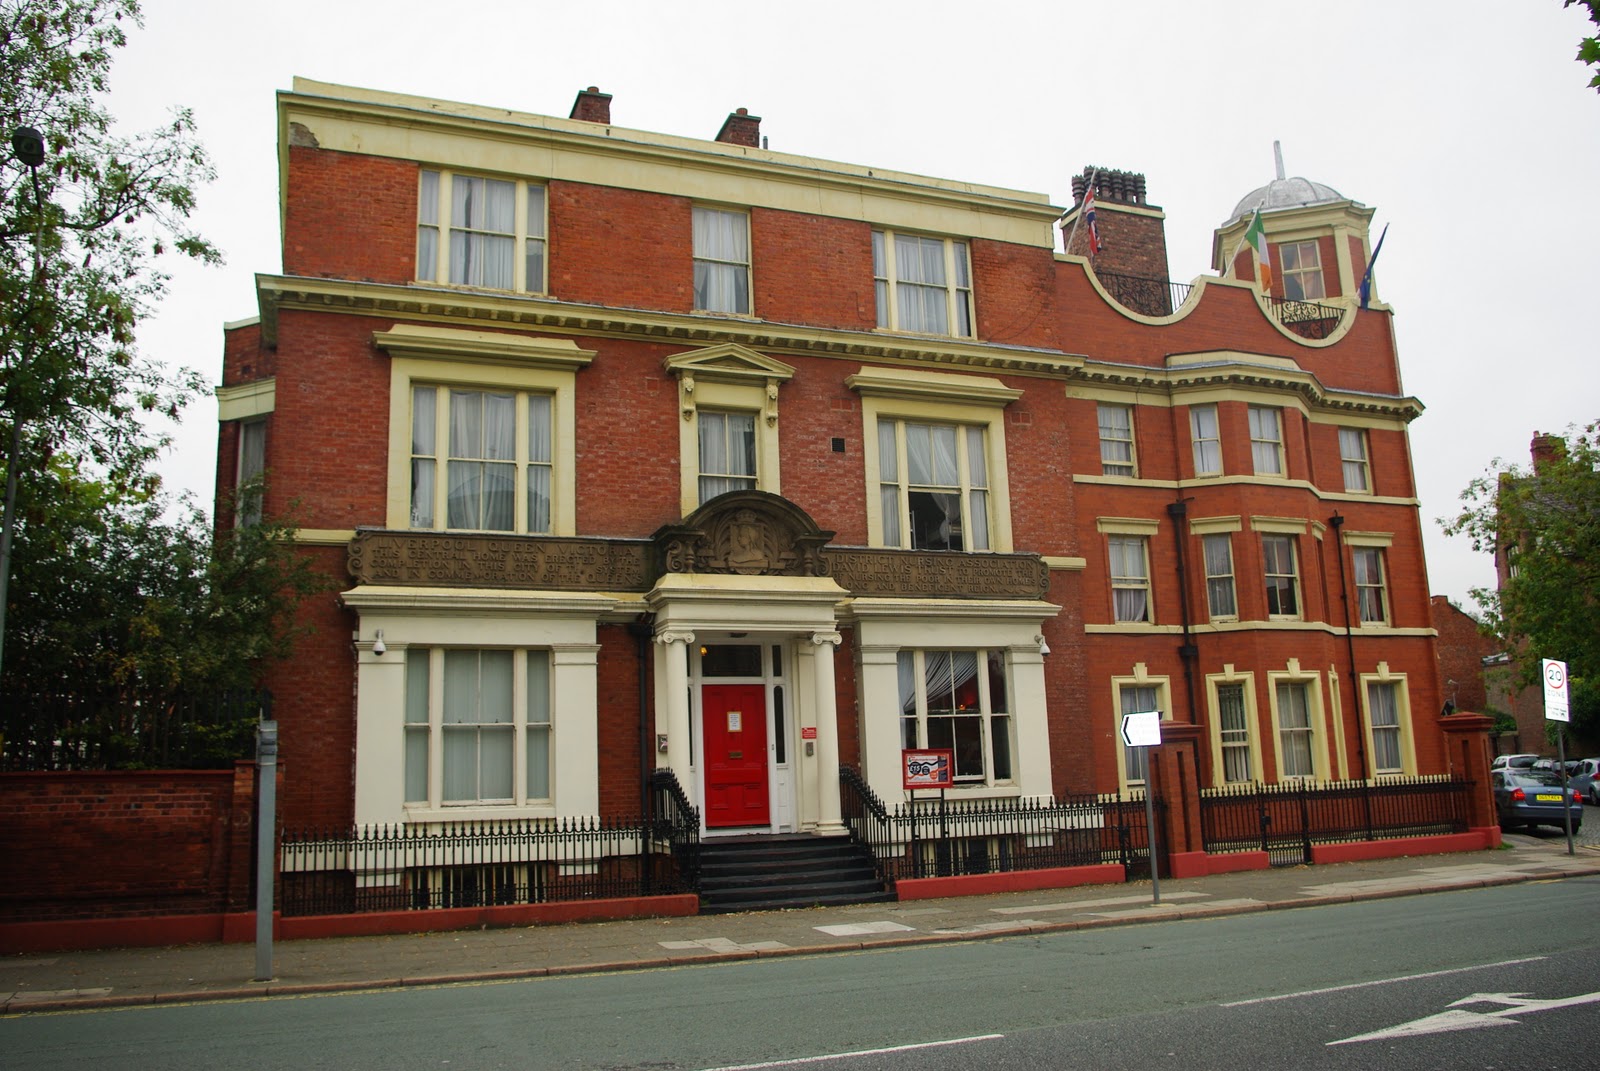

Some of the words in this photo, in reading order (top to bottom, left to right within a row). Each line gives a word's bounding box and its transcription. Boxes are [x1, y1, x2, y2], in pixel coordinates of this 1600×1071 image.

[378, 538, 477, 552] LIVERPOOL
[488, 541, 545, 554] QUEEN
[557, 544, 634, 556] VICTORIA
[372, 549, 400, 559] THIS
[408, 550, 467, 560] CENTRAL
[473, 551, 507, 562] HOME
[512, 553, 537, 562] WAS
[545, 554, 596, 565] ERECTED
[603, 556, 616, 565] BY
[619, 557, 640, 567] THE
[835, 553, 893, 565] DISTRICT
[901, 556, 954, 567] NURSING
[958, 559, 1034, 570] ASSOCIATION
[370, 559, 449, 569] COMPLETION
[458, 561, 471, 570] IN
[477, 561, 505, 571] THIS
[513, 562, 540, 572] CITY
[547, 564, 561, 573] OF
[596, 565, 640, 576] SYSTEM
[832, 562, 870, 573] DAVID
[874, 563, 912, 574] LEWIS
[918, 565, 954, 576] TRUST
[958, 568, 968, 577] TO
[973, 568, 1012, 578] PROMOTE
[1016, 570, 1033, 579] THE
[375, 568, 400, 578] AND
[408, 570, 420, 579] IN
[428, 570, 535, 582] COMMEMORATION
[541, 573, 555, 583] OF
[559, 574, 580, 583] THE
[586, 573, 643, 585] QUEEN'S
[848, 573, 892, 582] NURSING
[895, 574, 911, 583] THE
[916, 574, 939, 584] POOR
[944, 576, 953, 585] IN
[956, 576, 981, 585] THEIR
[984, 577, 1003, 586] OWN
[1006, 577, 1036, 587] HOMES
[876, 582, 895, 591] AND
[901, 583, 963, 593] BENEFICENT
[1548, 669, 1562, 682] 20
[1547, 689, 1566, 699] ZONE
